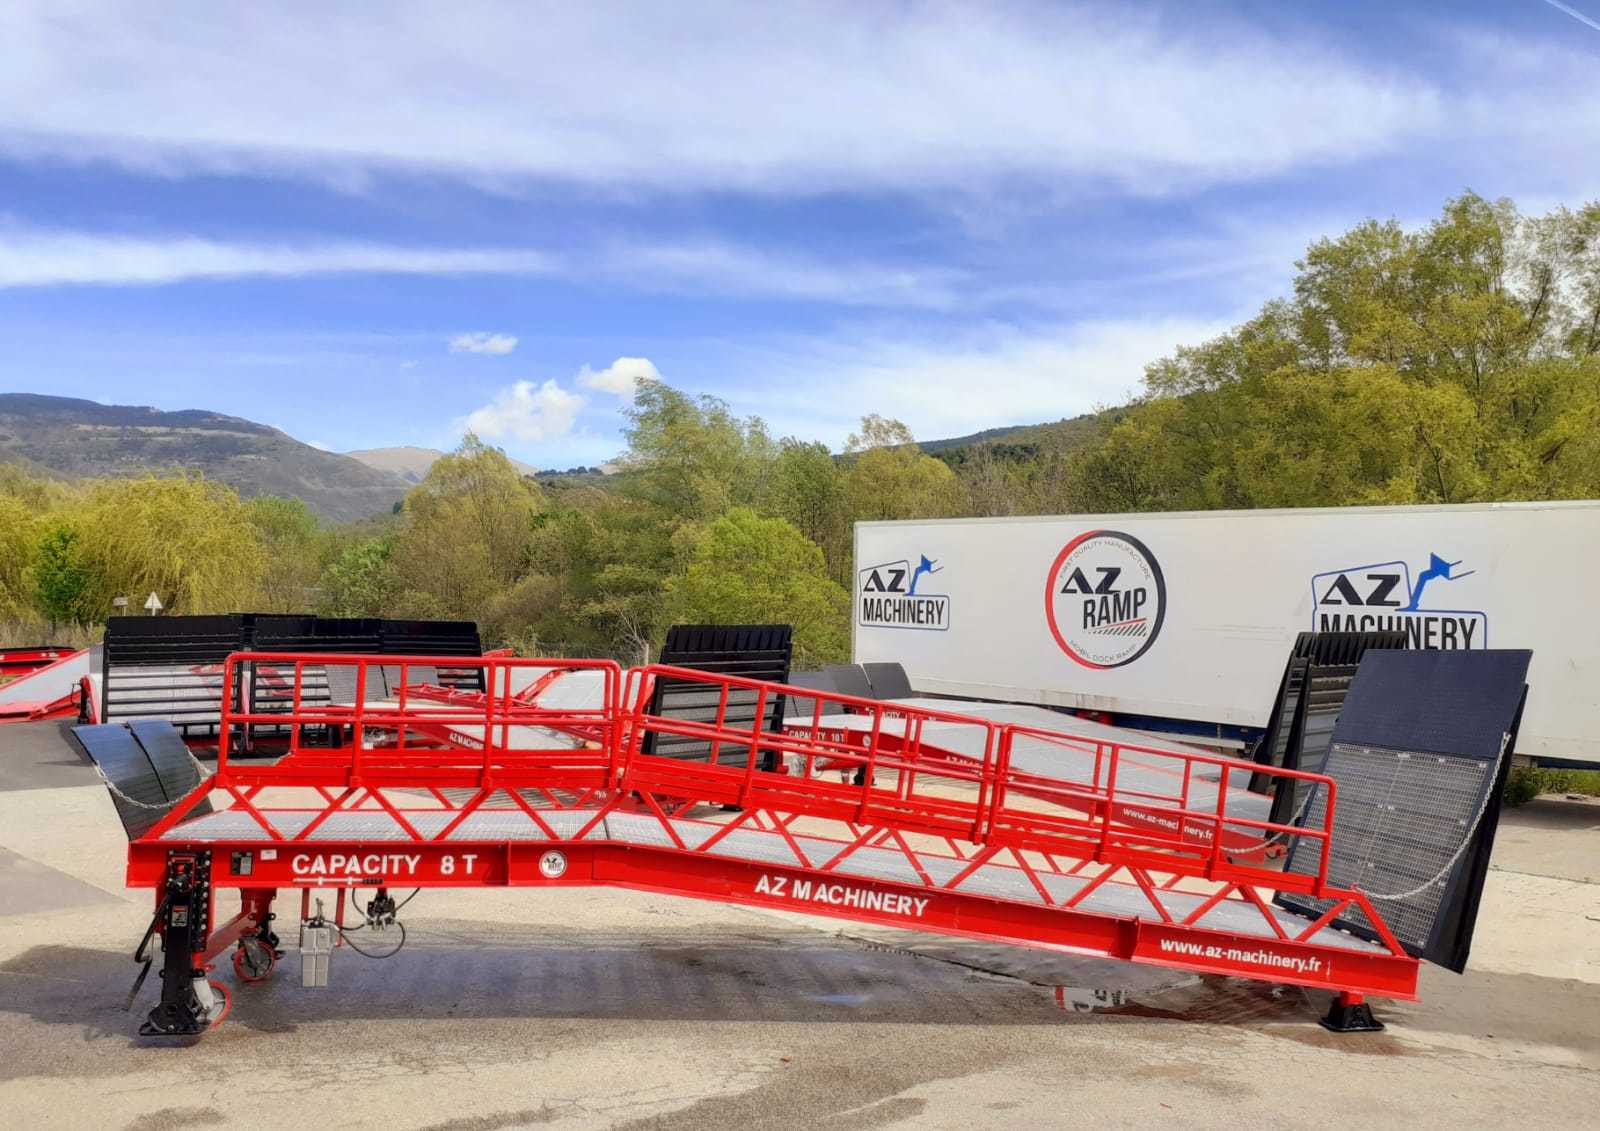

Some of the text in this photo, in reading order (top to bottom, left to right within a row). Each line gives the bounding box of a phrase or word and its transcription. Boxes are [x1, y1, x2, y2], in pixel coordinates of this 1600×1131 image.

[863, 569, 905, 592] AZ
[1060, 567, 1121, 594] AZ
[1320, 574, 1400, 606] AZ
[863, 598, 944, 625] MACHINERY
[1083, 588, 1147, 629] RAMP
[1123, 808, 1213, 840] www.az-macnery.fr
[292, 854, 421, 874] CAPACITY
[440, 855, 454, 875] 8
[462, 854, 477, 874] T
[754, 874, 928, 917] AZ MACHINERY
[1161, 938, 1321, 973] www.az-machinery.fr
